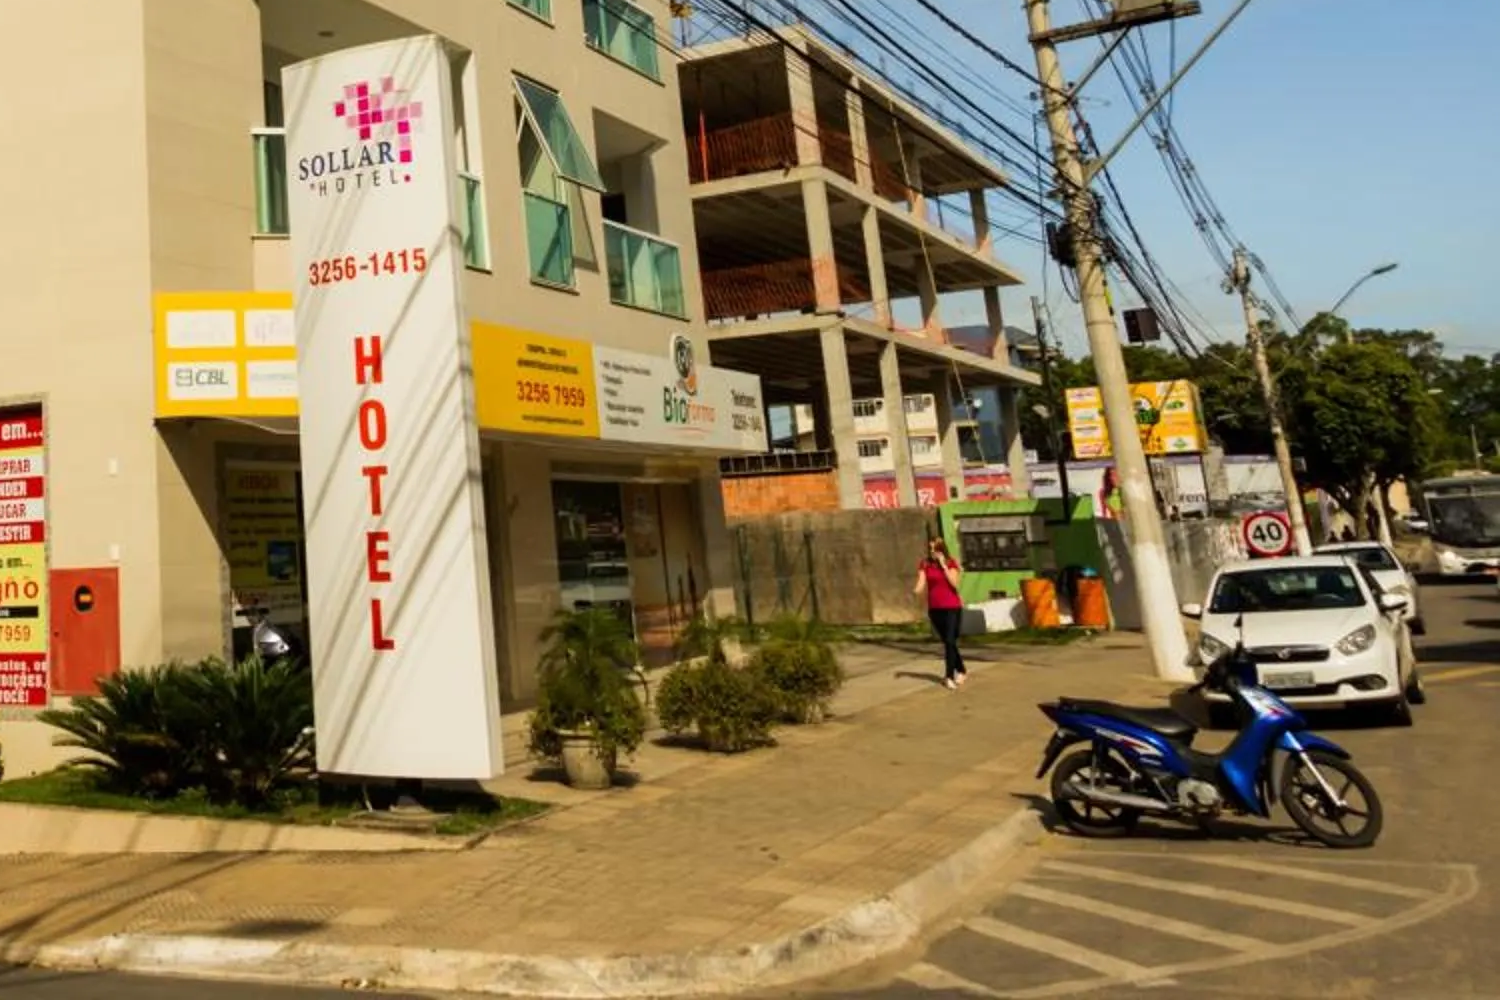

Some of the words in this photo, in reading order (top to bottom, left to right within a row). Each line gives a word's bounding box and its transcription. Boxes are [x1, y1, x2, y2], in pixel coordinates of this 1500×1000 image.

[299, 141, 395, 180] SOLLAR
[318, 169, 399, 196] HOTEL
[308, 248, 427, 286] 3256-1415
[516, 380, 550, 405] 3256
[553, 384, 585, 408] 7959
[1, 421, 44, 441] em...
[354, 336, 395, 651] HOTEL
[1252, 522, 1282, 542] 40
